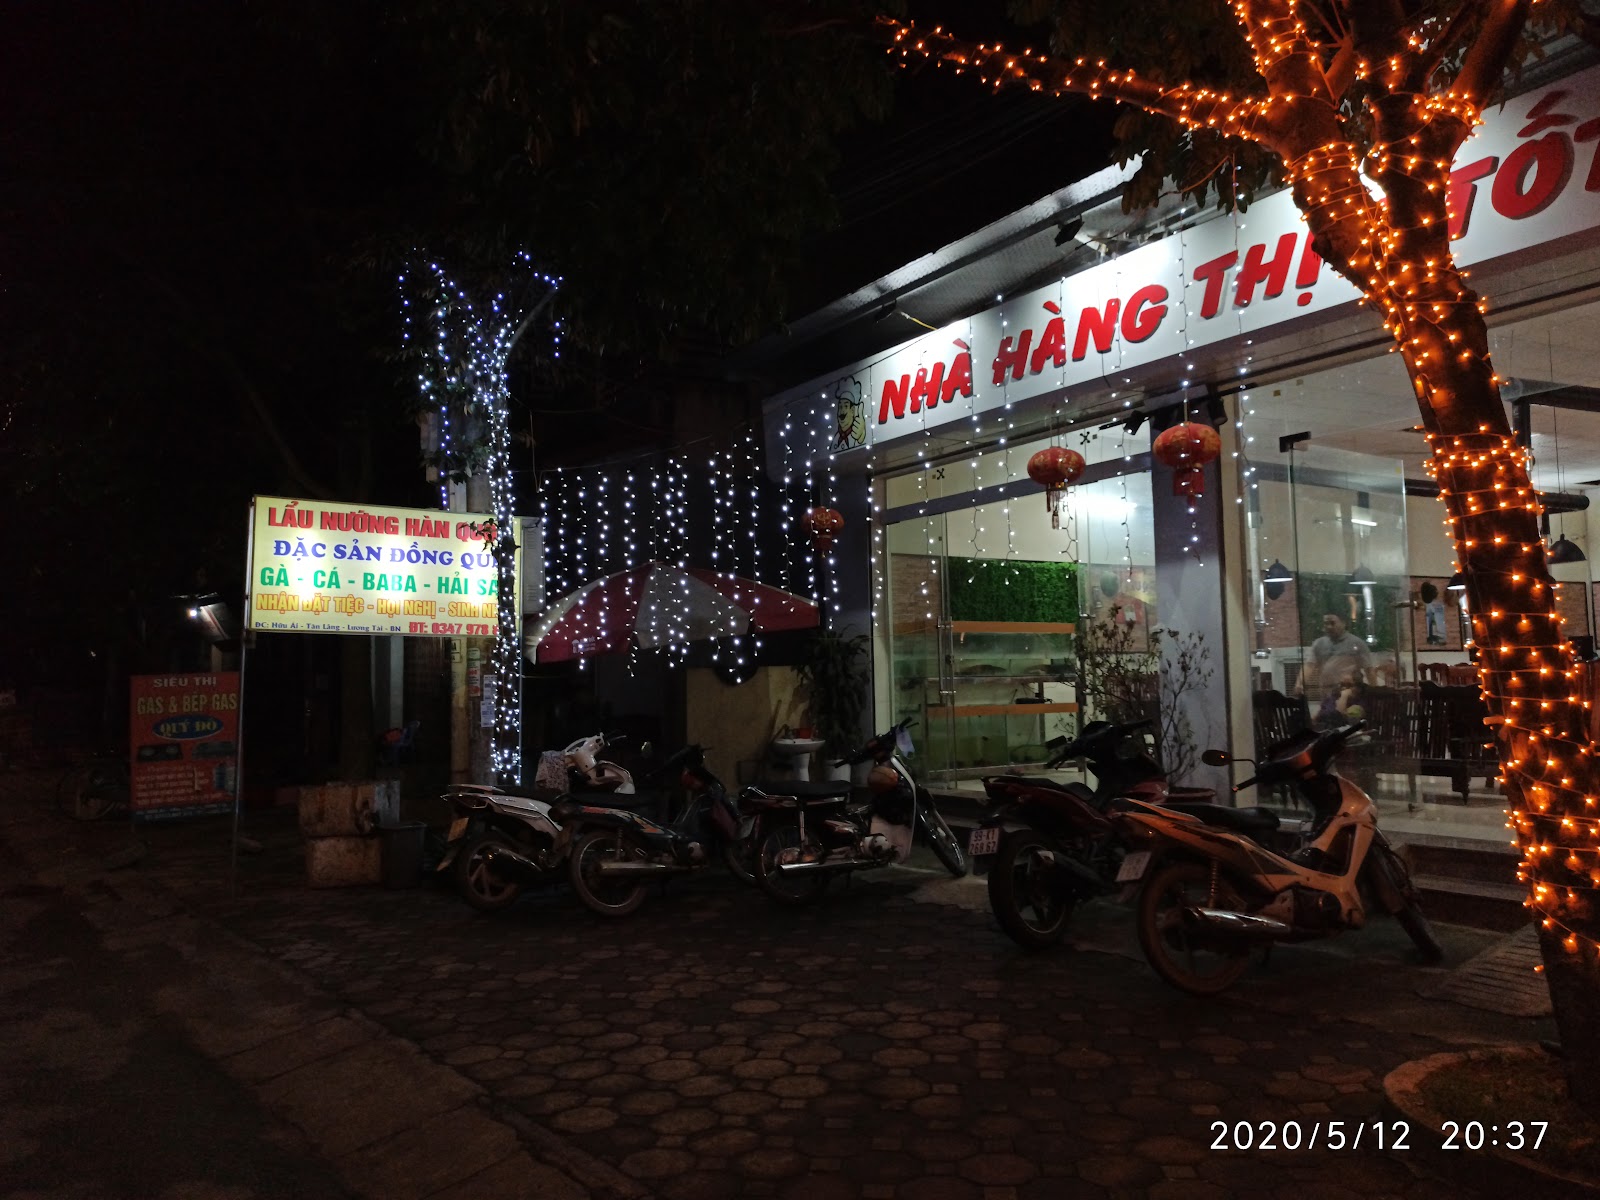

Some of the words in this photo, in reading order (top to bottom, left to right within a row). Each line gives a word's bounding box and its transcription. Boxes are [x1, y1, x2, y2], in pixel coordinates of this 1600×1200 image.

[877, 339, 974, 424] NHÀ
[990, 282, 1169, 386] HÀNG
[1190, 229, 1326, 308] THỊ
[268, 500, 314, 529] LẨU
[320, 510, 399, 535] NƯỚNG
[405, 514, 450, 539] HÀN
[273, 536, 327, 561] ĐẶC
[333, 538, 382, 561] SẢN
[389, 541, 453, 566] ĐỒNG
[260, 563, 289, 587] GÀ
[313, 566, 341, 589] CÁ
[362, 572, 417, 593] BABA
[437, 571, 469, 595] HẢI
[256, 590, 299, 614] NHẬN
[302, 593, 331, 616] ĐẶT
[333, 594, 364, 616] TIỆC
[403, 599, 436, 619] NGHỊ
[448, 601, 479, 618] SINH
[408, 621, 429, 634] ĐT:
[431, 622, 463, 635] 0347
[466, 623, 489, 636] 978
[193, 676, 217, 687] THỊ
[137, 696, 164, 715] GAS
[168, 696, 178, 713] &
[182, 691, 208, 713] BẾP
[211, 693, 237, 711] GAS
